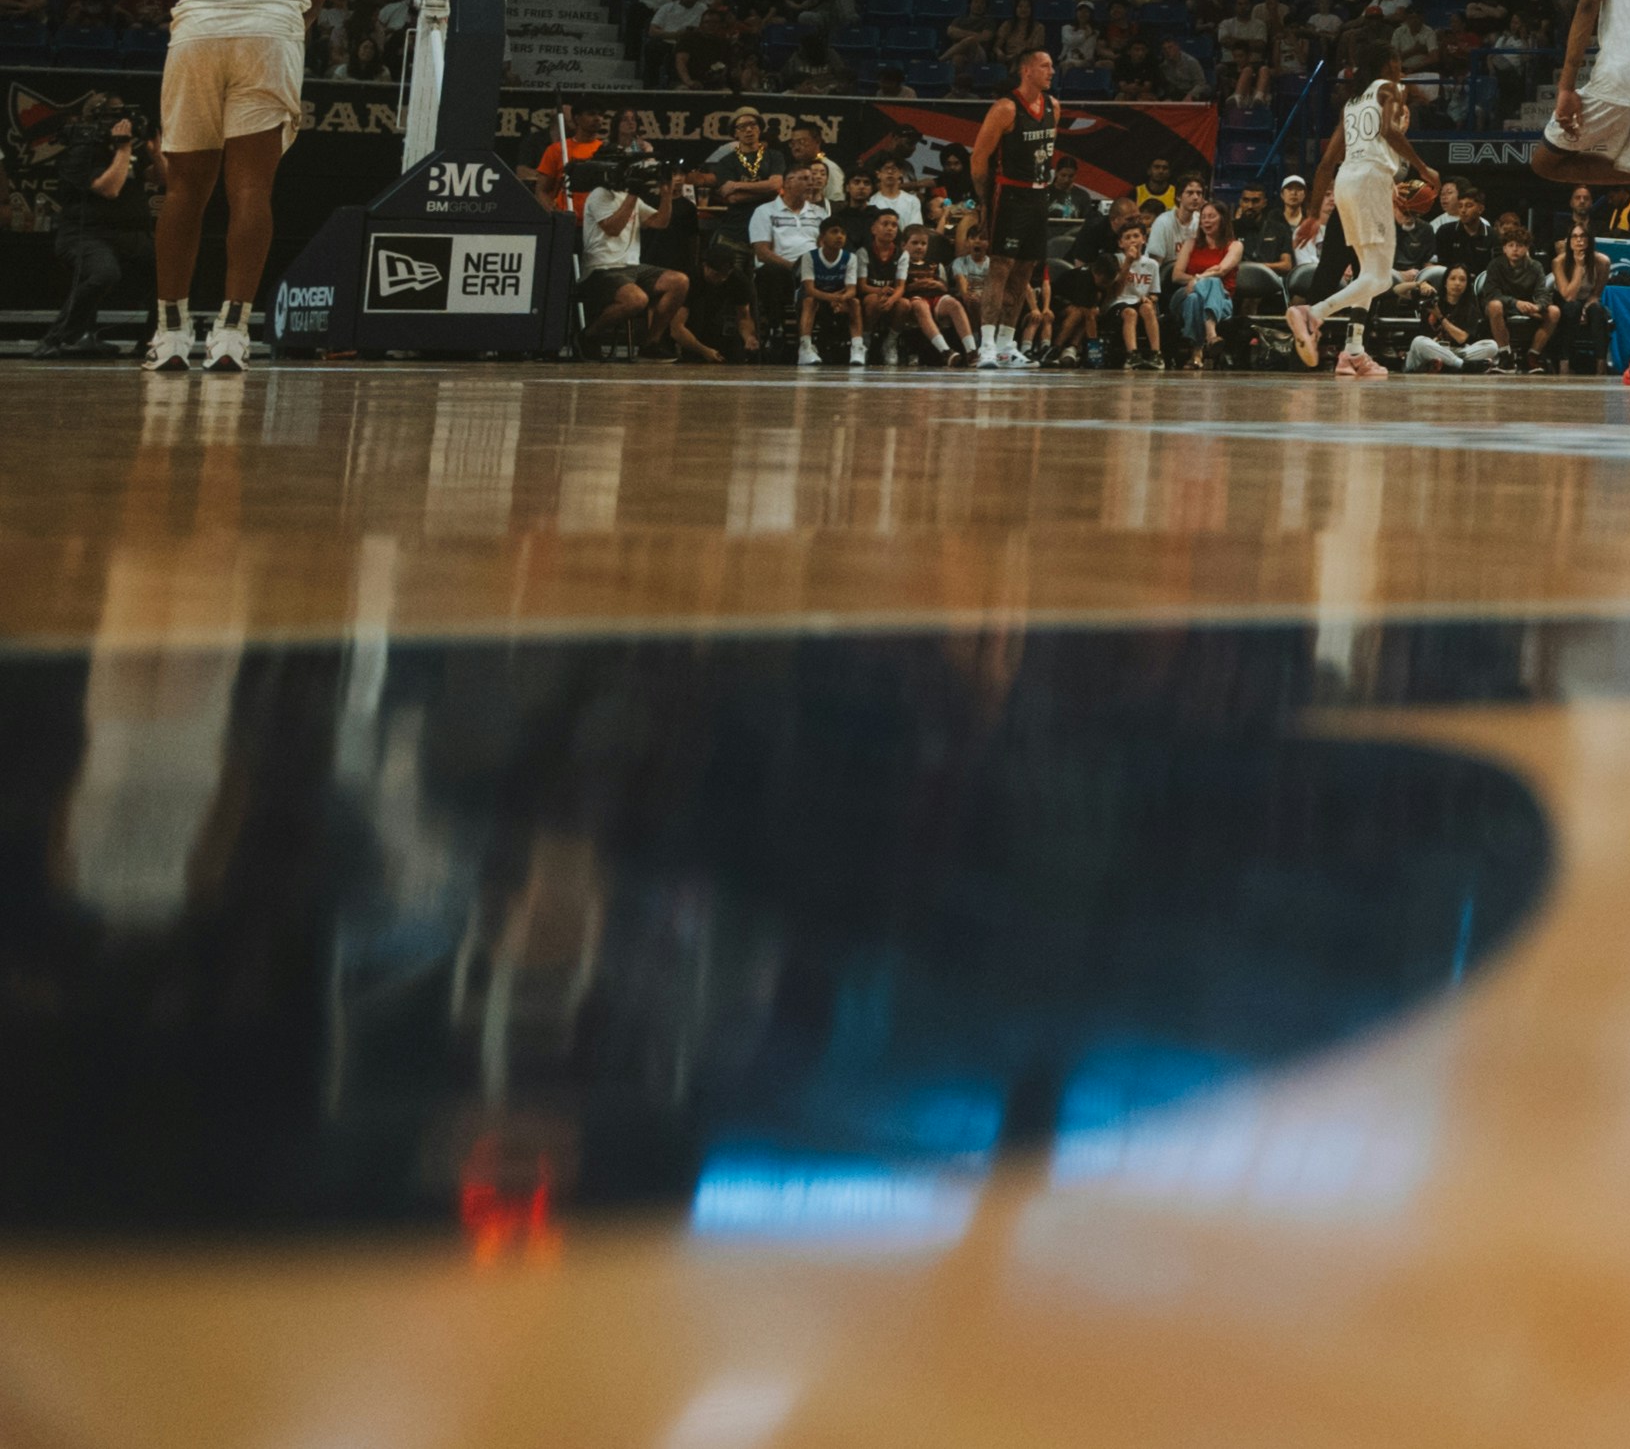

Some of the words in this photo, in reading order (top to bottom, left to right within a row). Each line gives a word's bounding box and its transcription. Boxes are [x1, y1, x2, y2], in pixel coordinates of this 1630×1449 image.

[1345, 106, 1381, 146] 30
[428, 162, 500, 197] BMG
[426, 201, 498, 213] BMGROUP
[464, 253, 522, 274] NEW
[462, 275, 520, 296] ERA
[288, 286, 335, 308] OXYGEN
